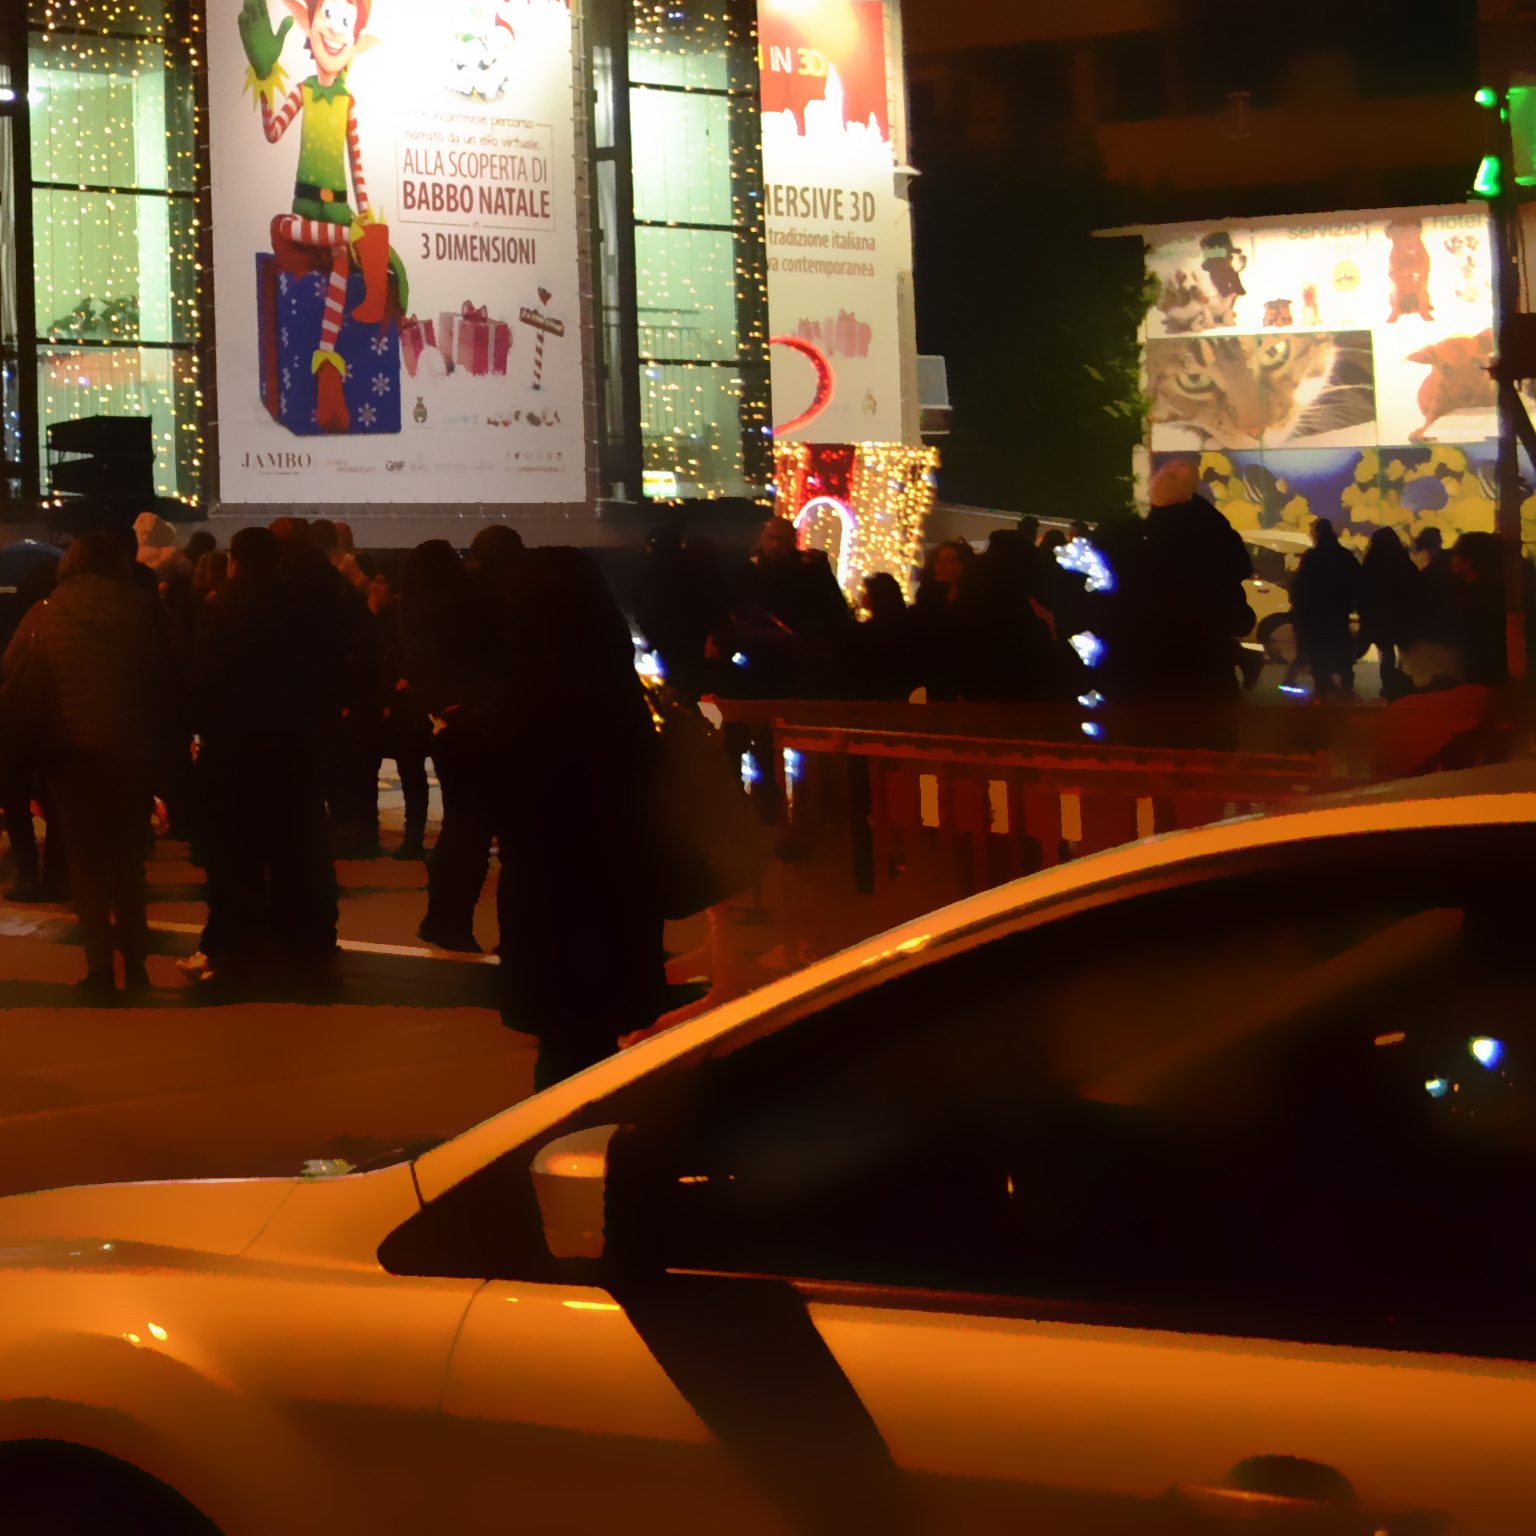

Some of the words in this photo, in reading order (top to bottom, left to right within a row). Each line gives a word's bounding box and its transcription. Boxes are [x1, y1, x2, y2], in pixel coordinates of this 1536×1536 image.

[770, 45, 792, 73] IN
[797, 47, 827, 77] 3D
[405, 130, 444, 144] narrato
[448, 133, 460, 144] da
[464, 135, 476, 145] un
[480, 134, 499, 147] elfo
[491, 116, 535, 132] percorso
[403, 148, 445, 176] ALLA
[448, 151, 528, 183] SCOPERTA
[532, 157, 547, 184] DI
[403, 180, 473, 214] BABBO
[479, 186, 551, 219] NATALE
[850, 191, 875, 223] 3D
[421, 233, 430, 260] 3
[435, 232, 536, 265] DIMENSIONI
[769, 227, 829, 249] tradizione
[831, 230, 875, 251] italiana
[781, 256, 874, 279] contemporanea
